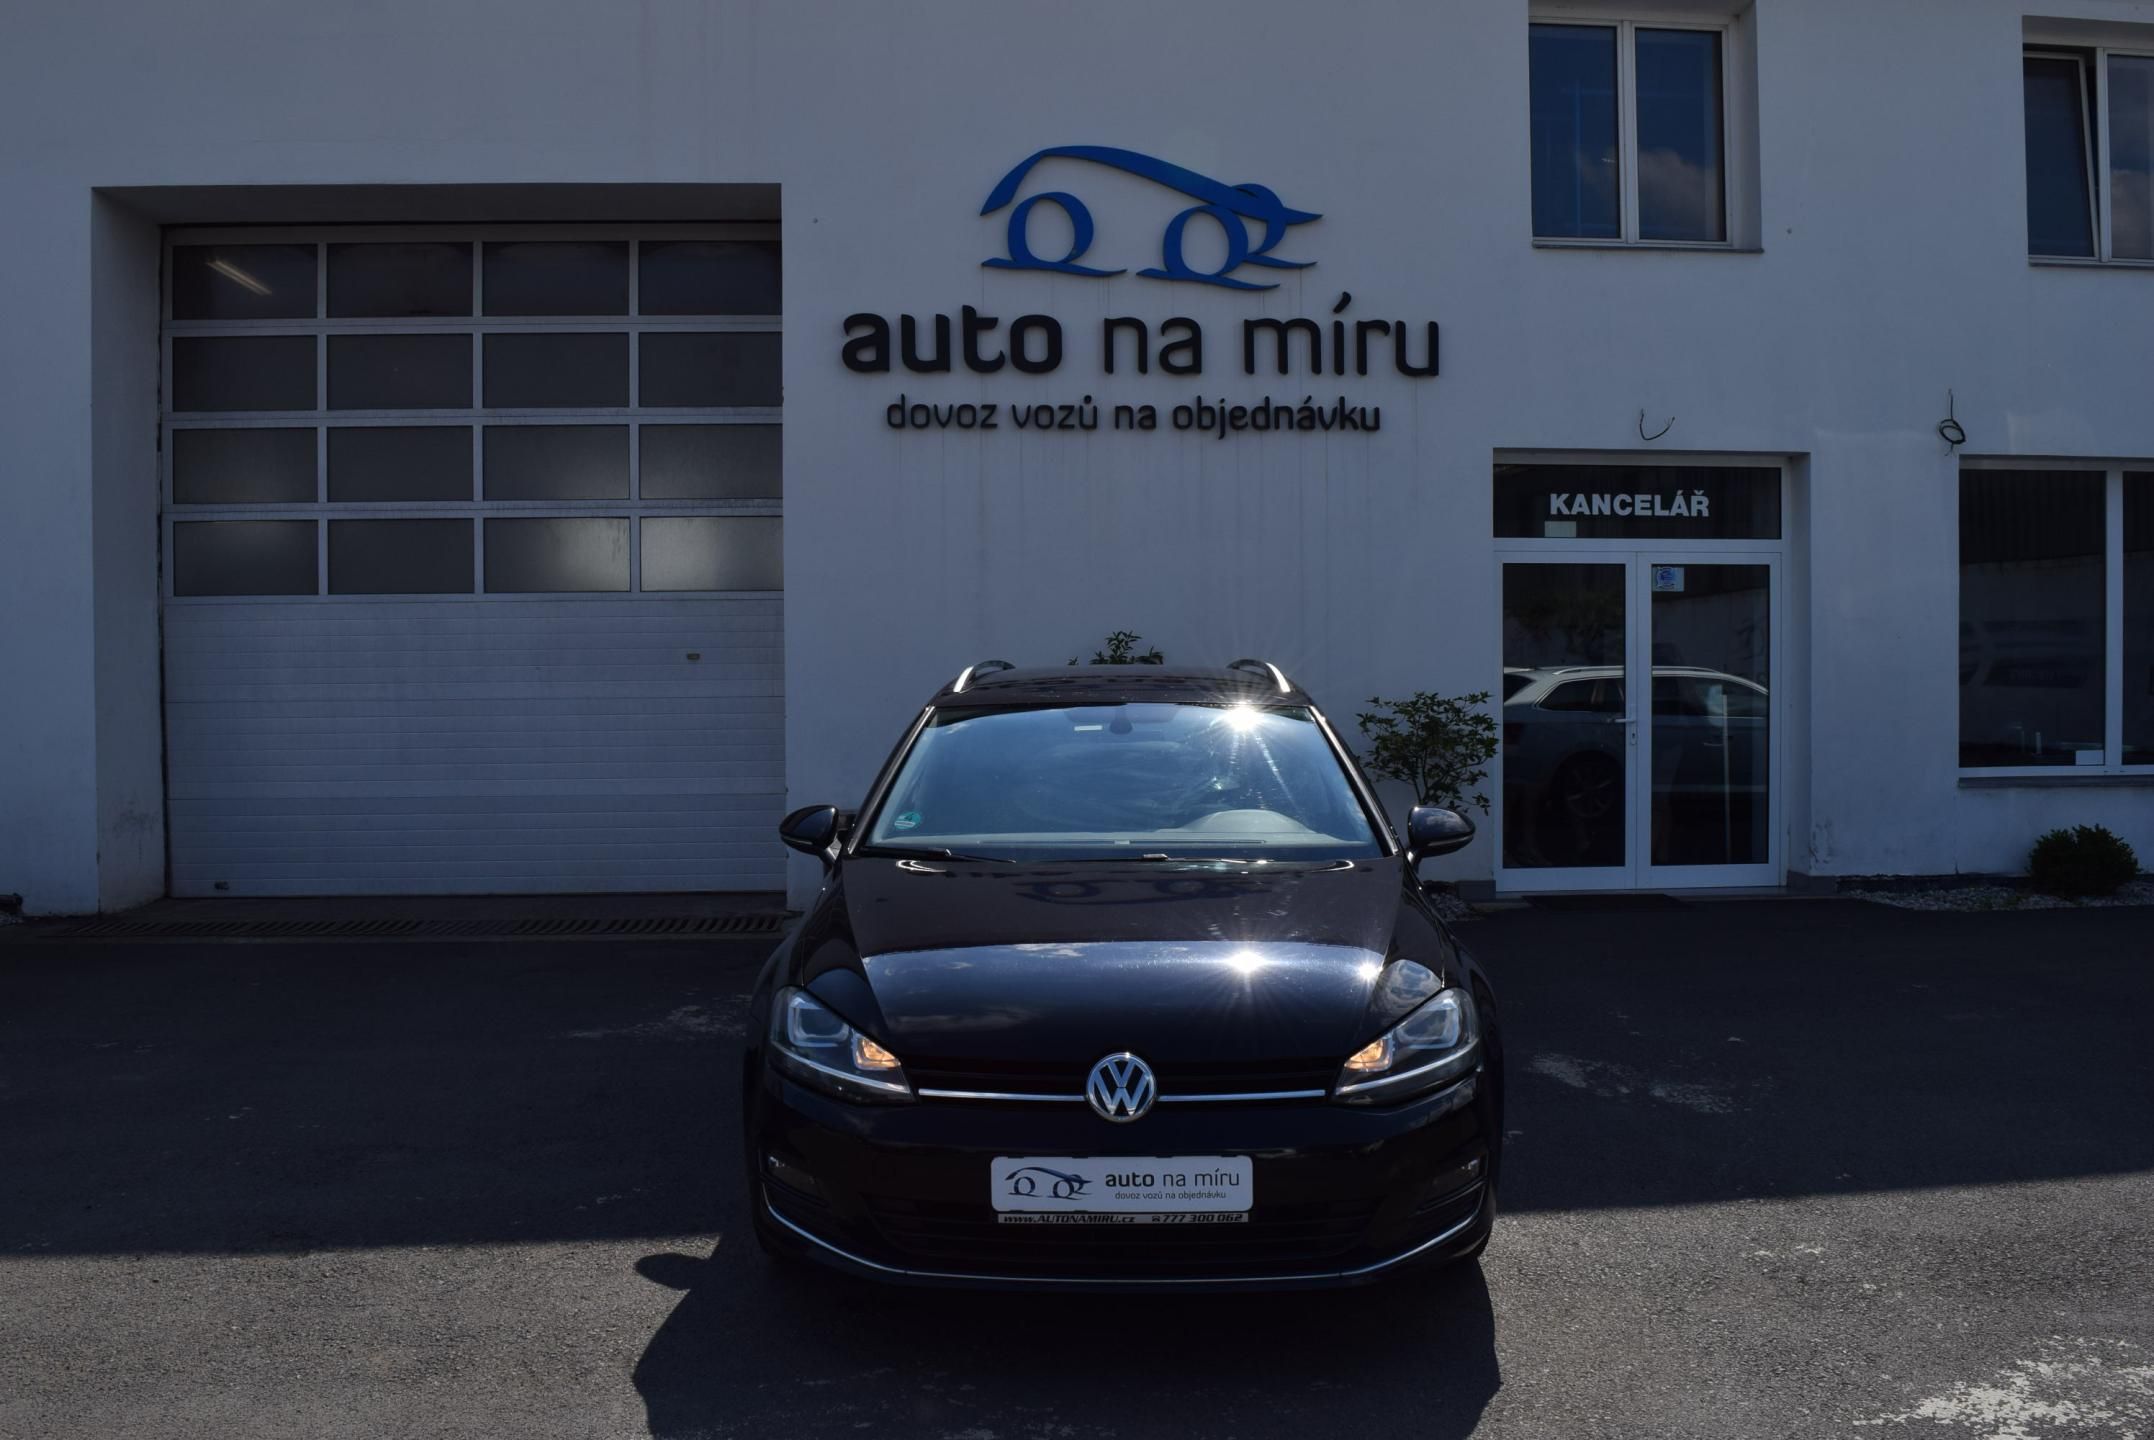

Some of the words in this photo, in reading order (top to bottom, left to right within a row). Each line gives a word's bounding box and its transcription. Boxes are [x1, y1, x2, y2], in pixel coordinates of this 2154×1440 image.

[842, 305, 1063, 374] auto
[1103, 317, 1203, 375] na
[1243, 292, 1440, 376] míru
[886, 394, 999, 430] dovoz
[1011, 394, 1098, 430] vozů
[1114, 404, 1157, 430] na
[1172, 396, 1380, 440] objednávku
[1550, 489, 1710, 517] KANCELÁŘ
[1105, 1171, 1155, 1188] auto
[1163, 1173, 1186, 1187] na
[1194, 1167, 1240, 1187] míru
[1114, 1190, 1141, 1200] dovoz
[1165, 1191, 1176, 1200] na
[1178, 1189, 1227, 1201] objednávku
[1161, 1213, 1187, 1224] 777
